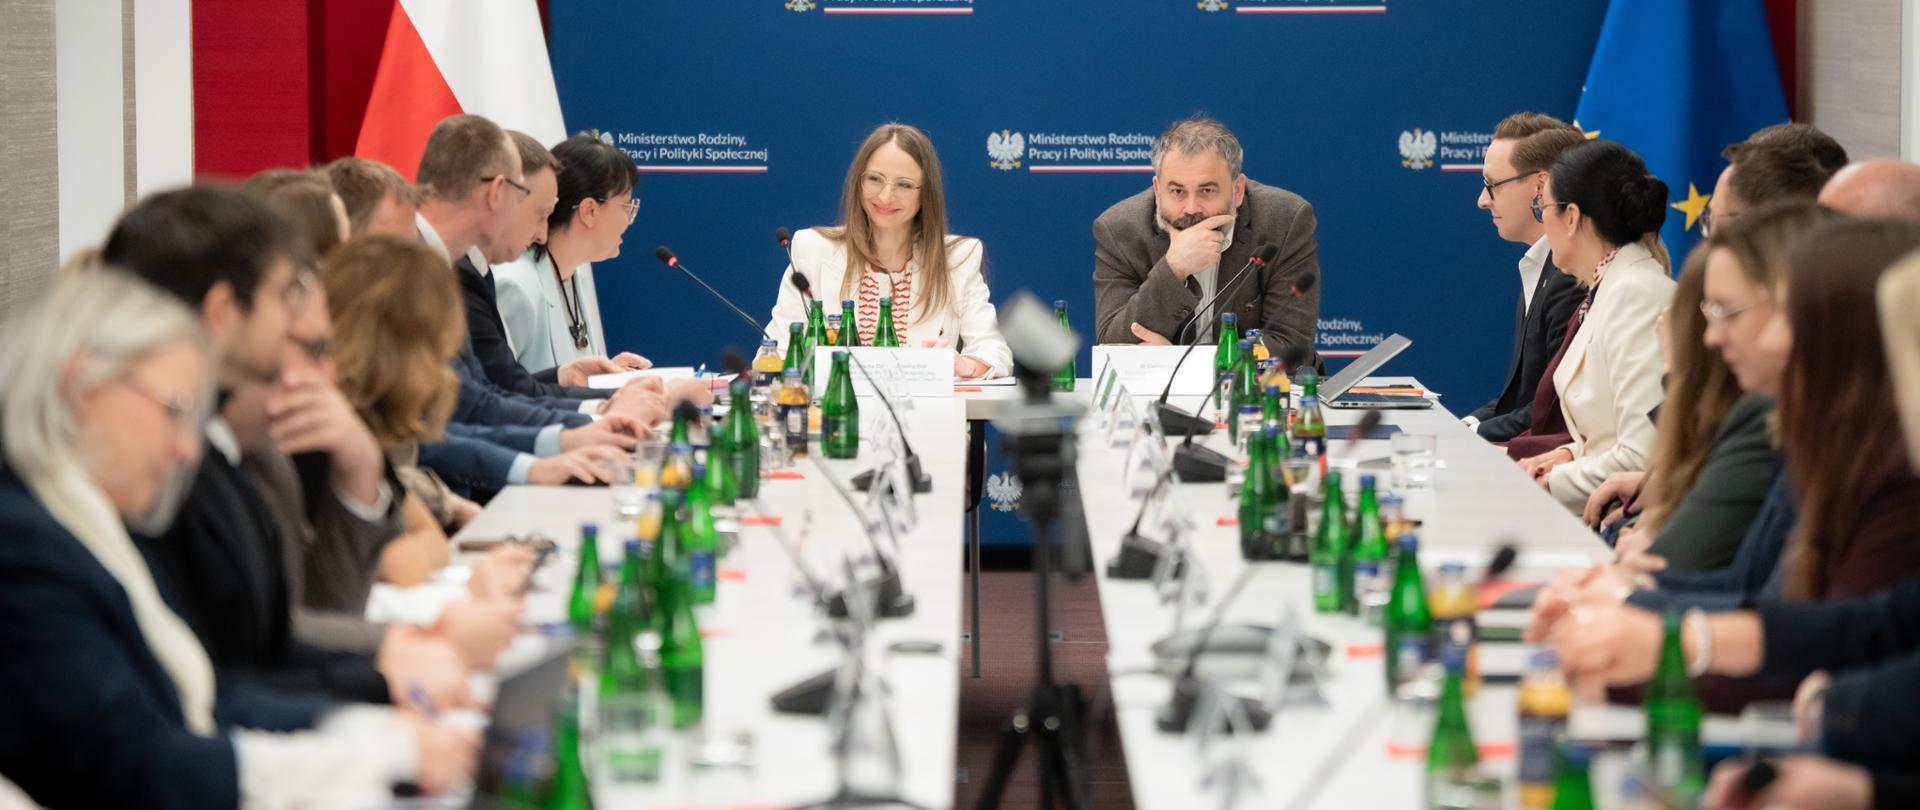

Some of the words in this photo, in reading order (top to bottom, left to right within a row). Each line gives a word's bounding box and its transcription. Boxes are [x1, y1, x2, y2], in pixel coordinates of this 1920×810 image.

[618, 133, 696, 145] Ministerstwo
[698, 133, 747, 146] Rodziny,
[1029, 133, 1106, 145] Ministerstwo
[653, 148, 657, 159] i
[659, 148, 703, 161] Polityki
[705, 148, 768, 161] Społecznej
[1029, 148, 1061, 161] Pracy
[1063, 148, 1067, 159] i
[1069, 148, 1113, 161] Polityki
[1441, 146, 1473, 160] Pracy
[1475, 146, 1480, 157] i
